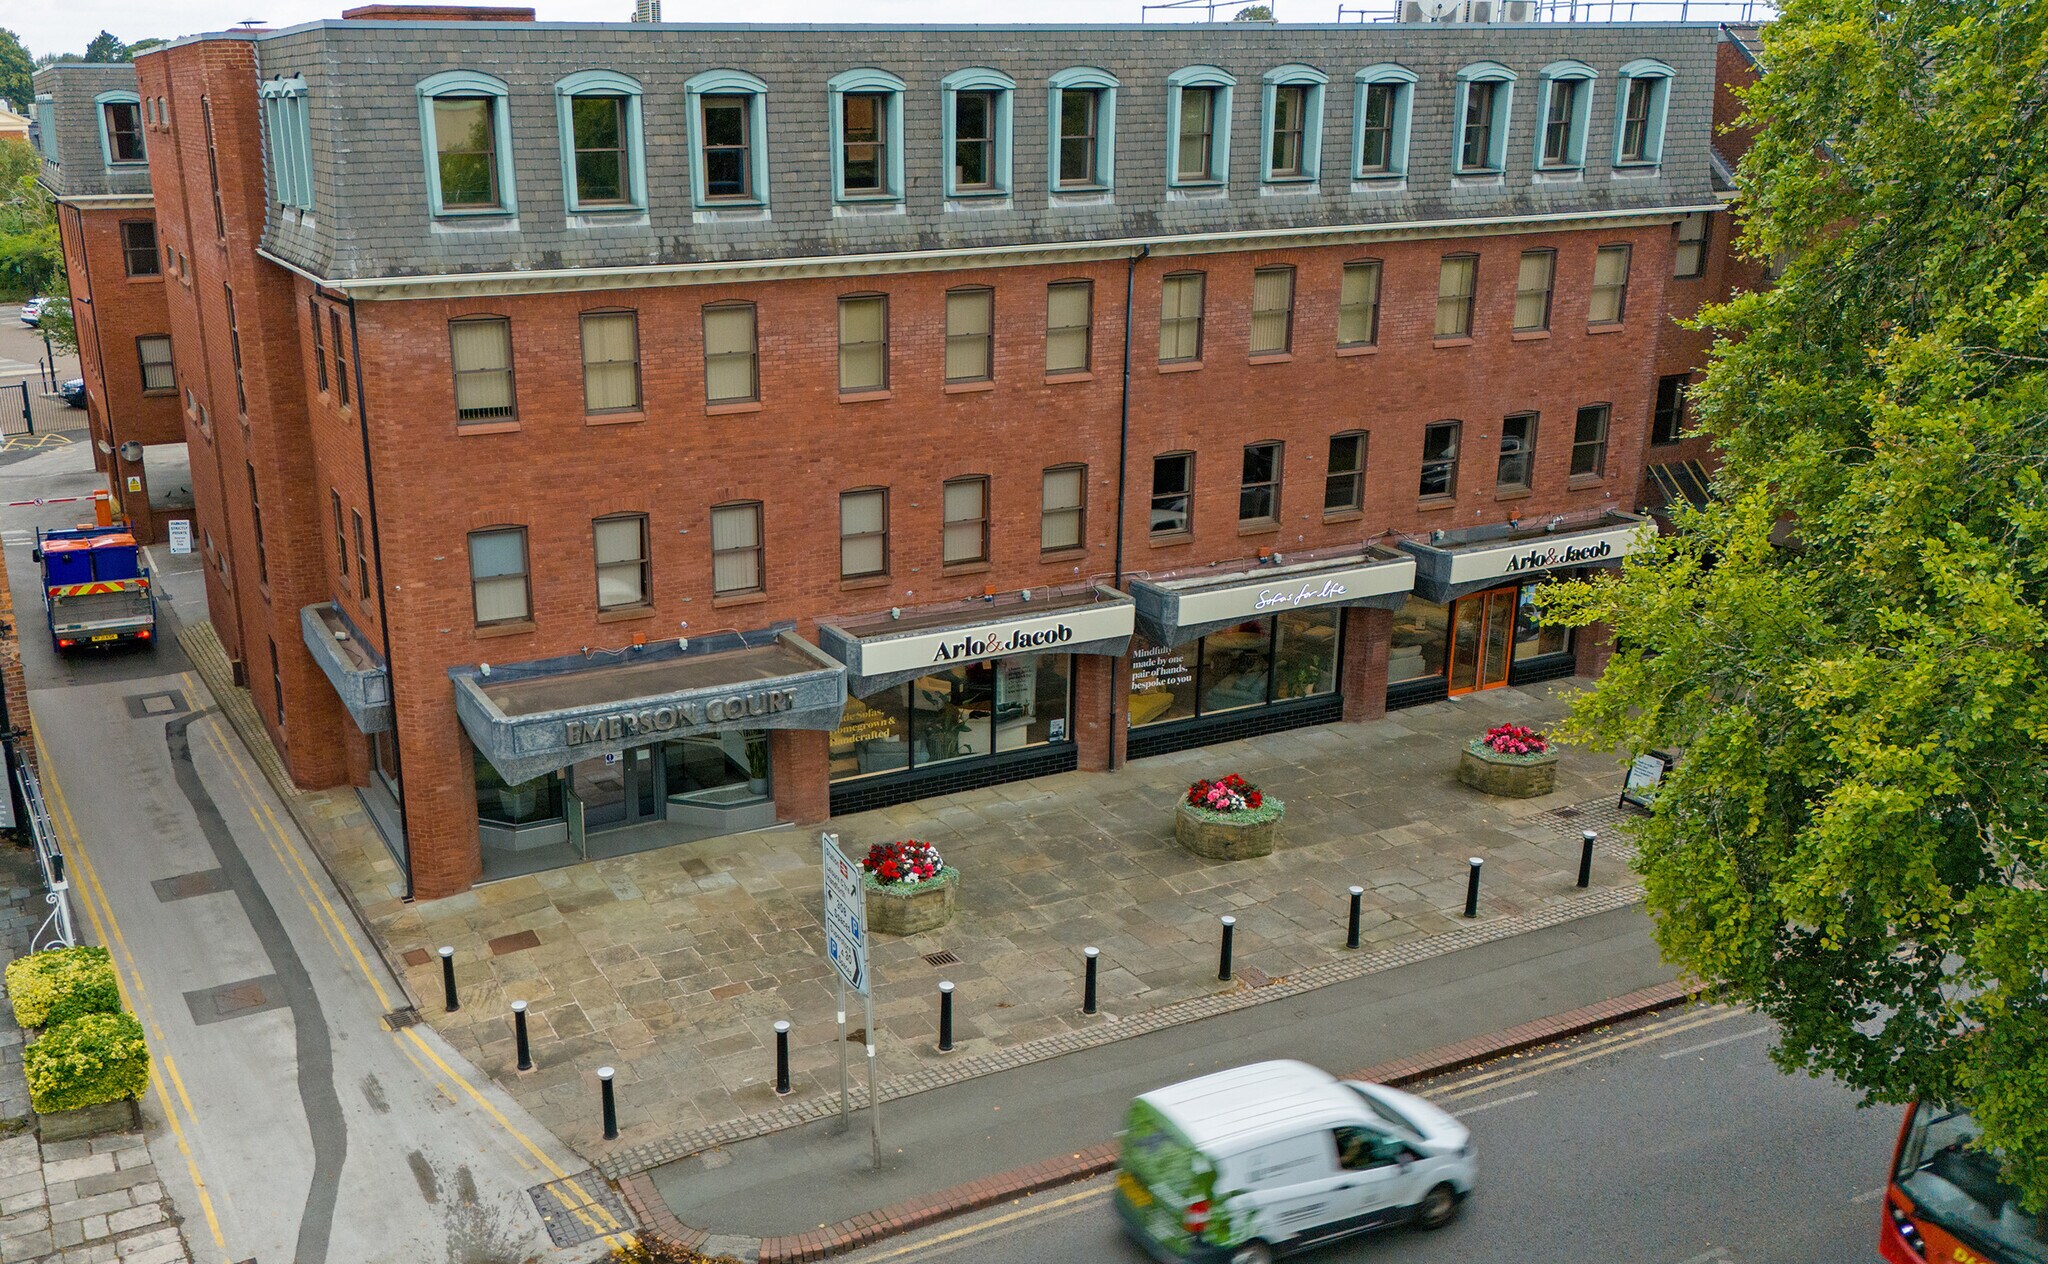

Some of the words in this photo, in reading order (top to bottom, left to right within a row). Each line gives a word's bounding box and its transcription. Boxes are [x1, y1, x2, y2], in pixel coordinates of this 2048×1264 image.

[1255, 589, 1293, 609] Sofas
[1293, 583, 1318, 606] for
[1316, 579, 1347, 598] life
[1132, 658, 1157, 669] made
[1157, 656, 1168, 667] by
[1168, 655, 1184, 664] one
[1131, 669, 1151, 682] pair
[1150, 666, 1160, 677] of
[1131, 677, 1167, 690] bespoke
[1167, 677, 1177, 685] to
[1176, 675, 1192, 686] you
[565, 702, 697, 747] EMERSON
[704, 687, 798, 723] COURT
